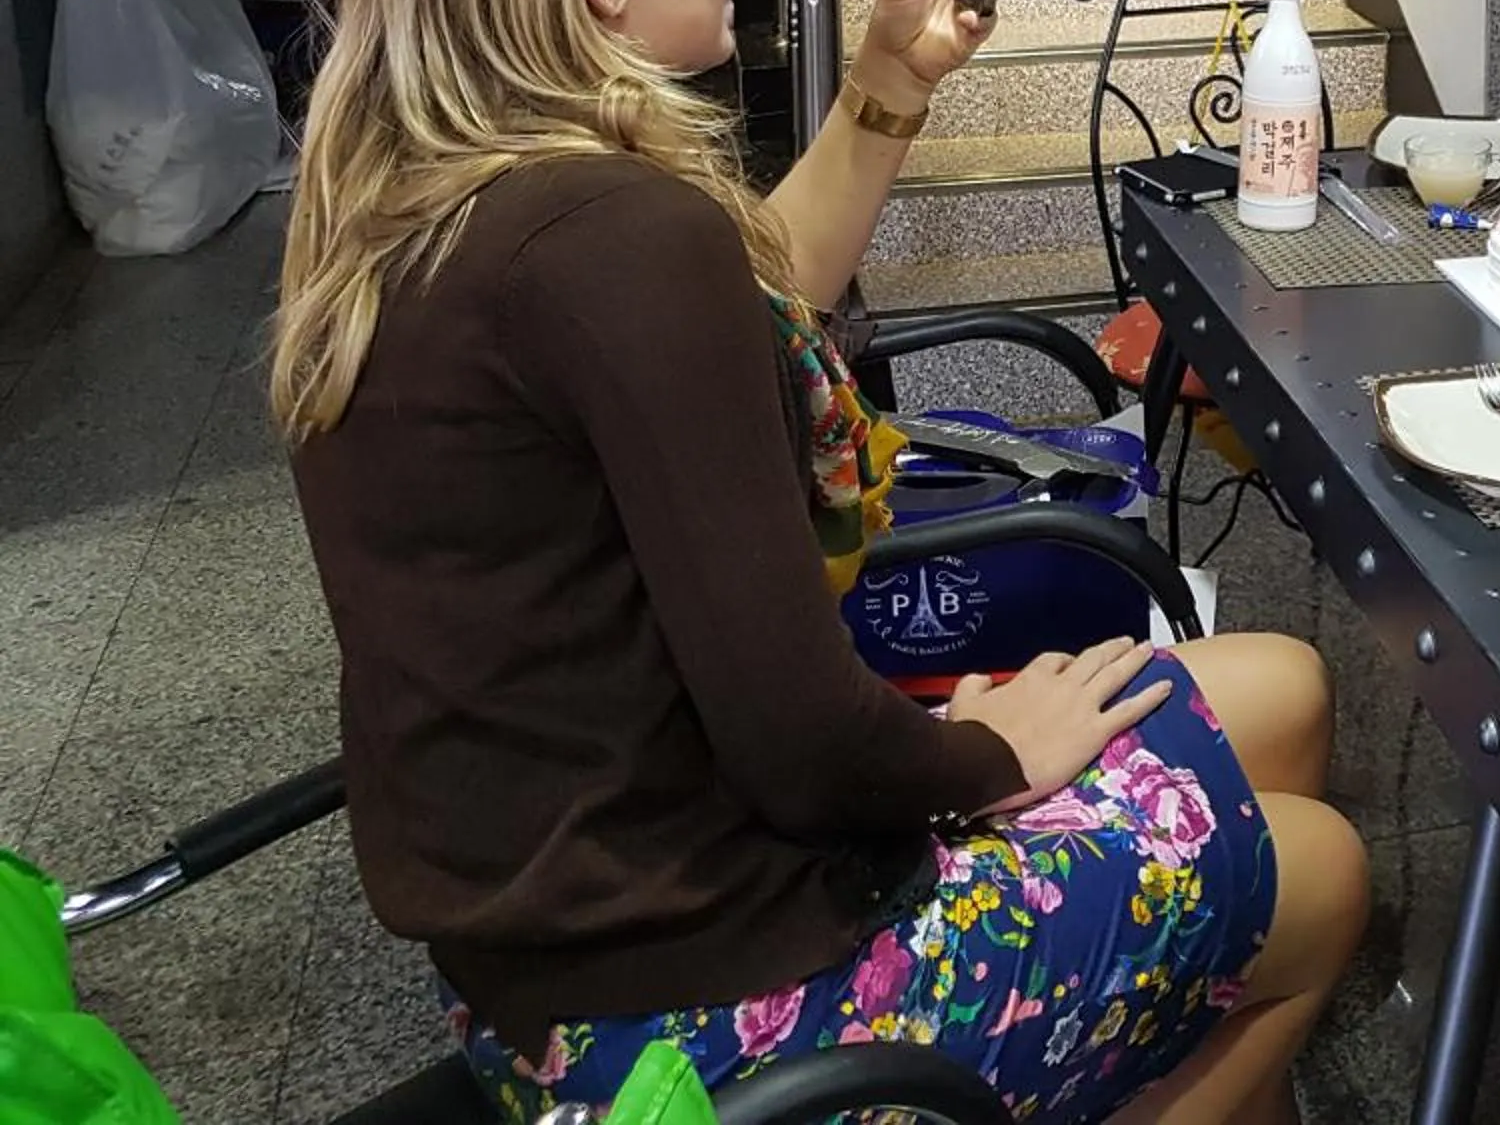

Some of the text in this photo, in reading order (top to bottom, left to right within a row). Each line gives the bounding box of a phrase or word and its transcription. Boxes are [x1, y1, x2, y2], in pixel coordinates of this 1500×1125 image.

[1278, 134, 1296, 170] 제주
[892, 594, 910, 617] P
[939, 592, 960, 615] B
